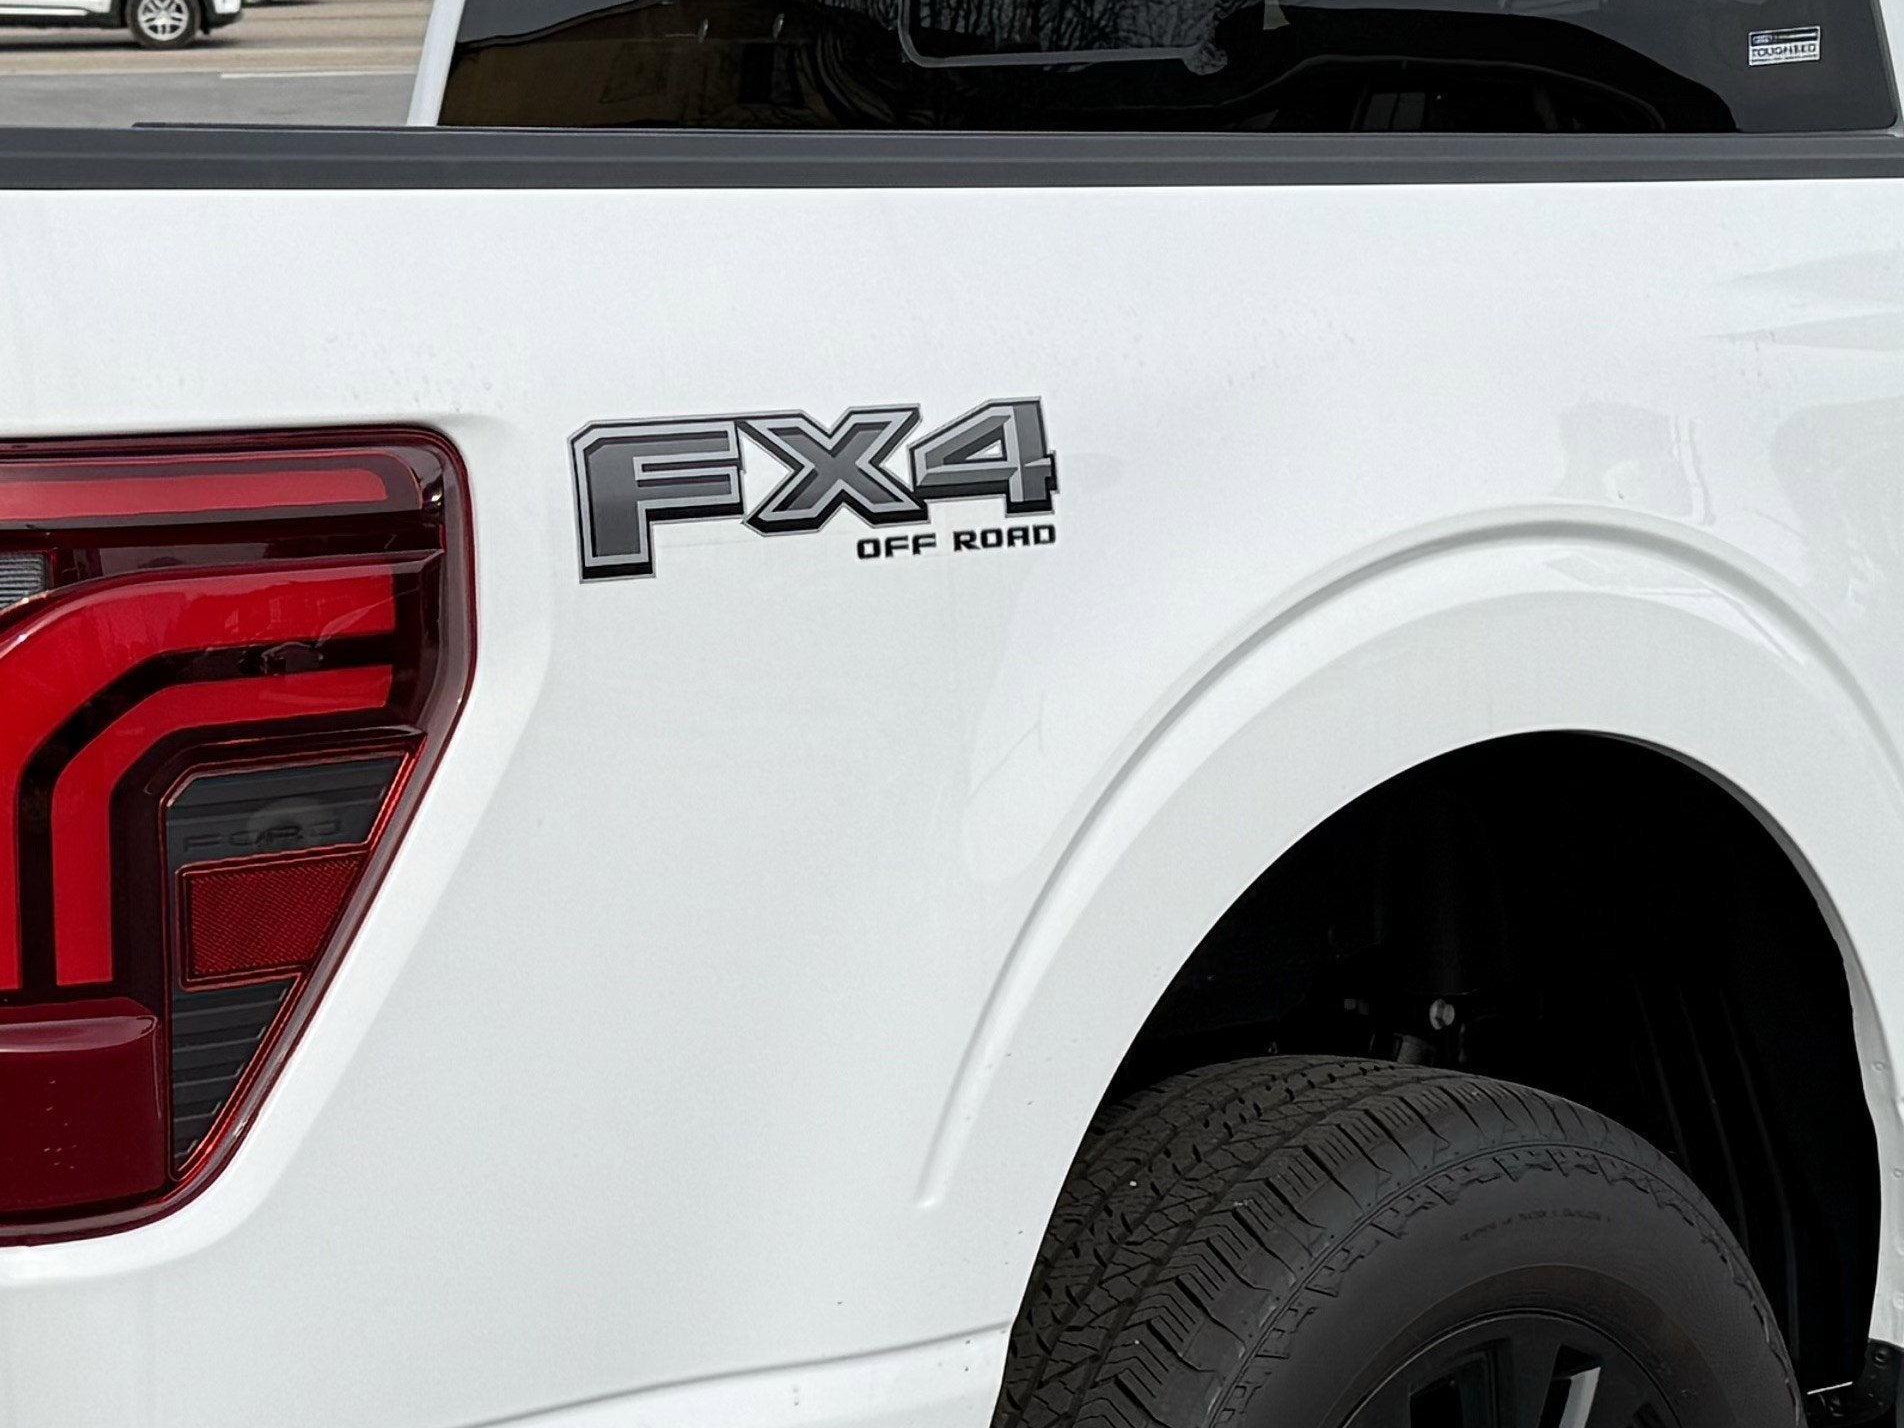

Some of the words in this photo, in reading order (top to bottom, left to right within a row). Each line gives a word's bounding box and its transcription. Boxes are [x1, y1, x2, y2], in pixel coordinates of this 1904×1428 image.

[568, 396, 1061, 584] FX4
[856, 533, 937, 560] OFF
[953, 524, 1056, 550] ROAD
